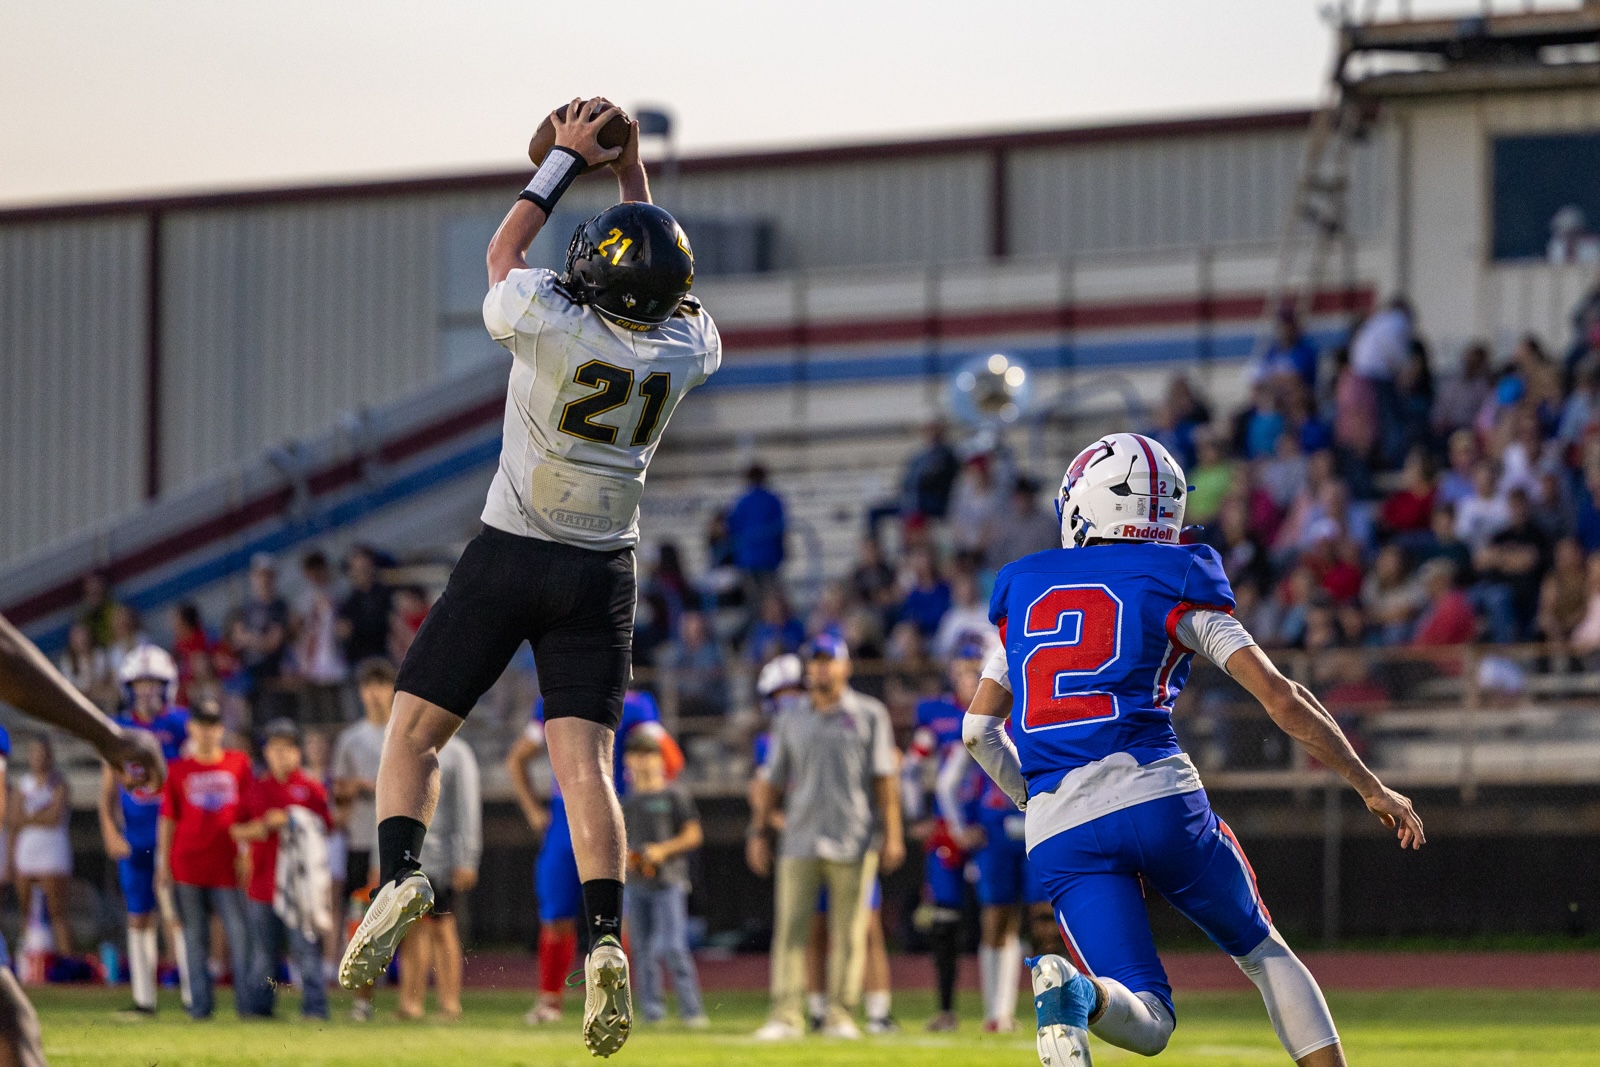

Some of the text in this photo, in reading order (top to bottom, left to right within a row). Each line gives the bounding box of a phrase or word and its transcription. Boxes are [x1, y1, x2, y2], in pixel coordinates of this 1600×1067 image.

[597, 227, 634, 266] 21
[557, 358, 671, 446] 21
[1159, 480, 1167, 494] 2
[555, 512, 609, 530] BATTLE
[1122, 524, 1174, 540] Riddell
[1021, 583, 1123, 734] 2
